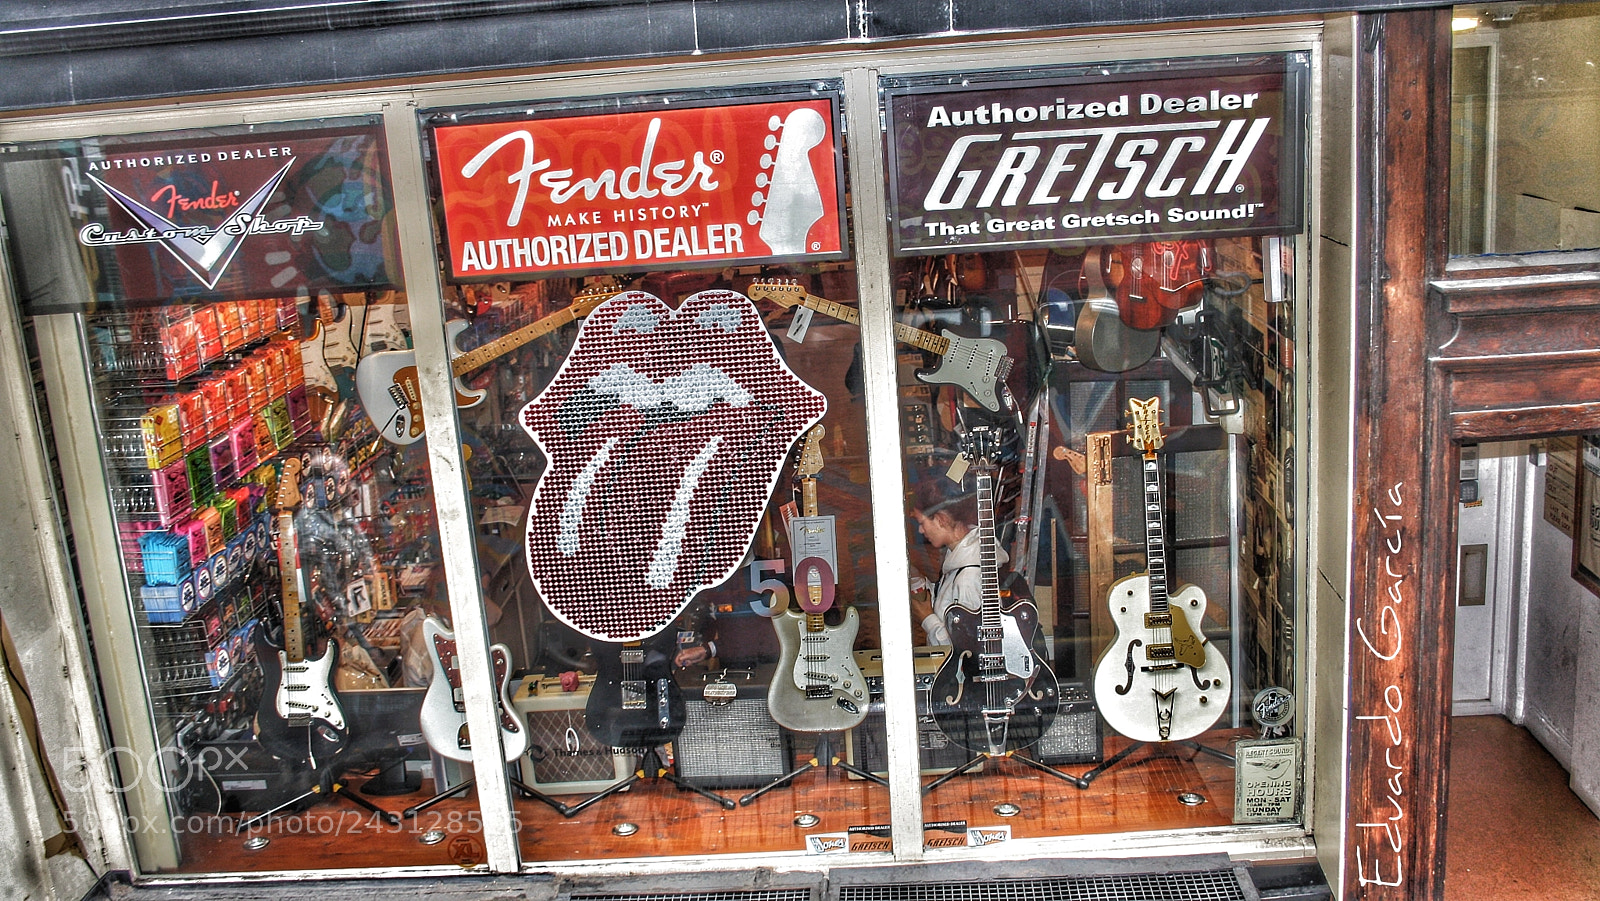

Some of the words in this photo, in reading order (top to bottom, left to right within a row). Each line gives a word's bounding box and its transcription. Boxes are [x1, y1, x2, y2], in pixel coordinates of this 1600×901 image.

[926, 95, 1128, 128] Authorized
[1140, 90, 1259, 115] Dealer
[89, 153, 211, 171] AUTHORIZED
[218, 147, 292, 162] DEALER
[79, 222, 216, 247] Custom
[225, 212, 324, 236] Shop
[547, 211, 601, 227] MAKE
[925, 221, 980, 237] That
[987, 216, 1055, 234] Great
[1062, 210, 1160, 230] Gretsch
[462, 230, 629, 271] AUTHORIZED
[635, 223, 744, 259] DEALER
[750, 556, 835, 617] 50
[1247, 780, 1291, 788] OPENING
[1247, 788, 1292, 796] HOURS
[851, 841, 890, 852] GRETSCH
